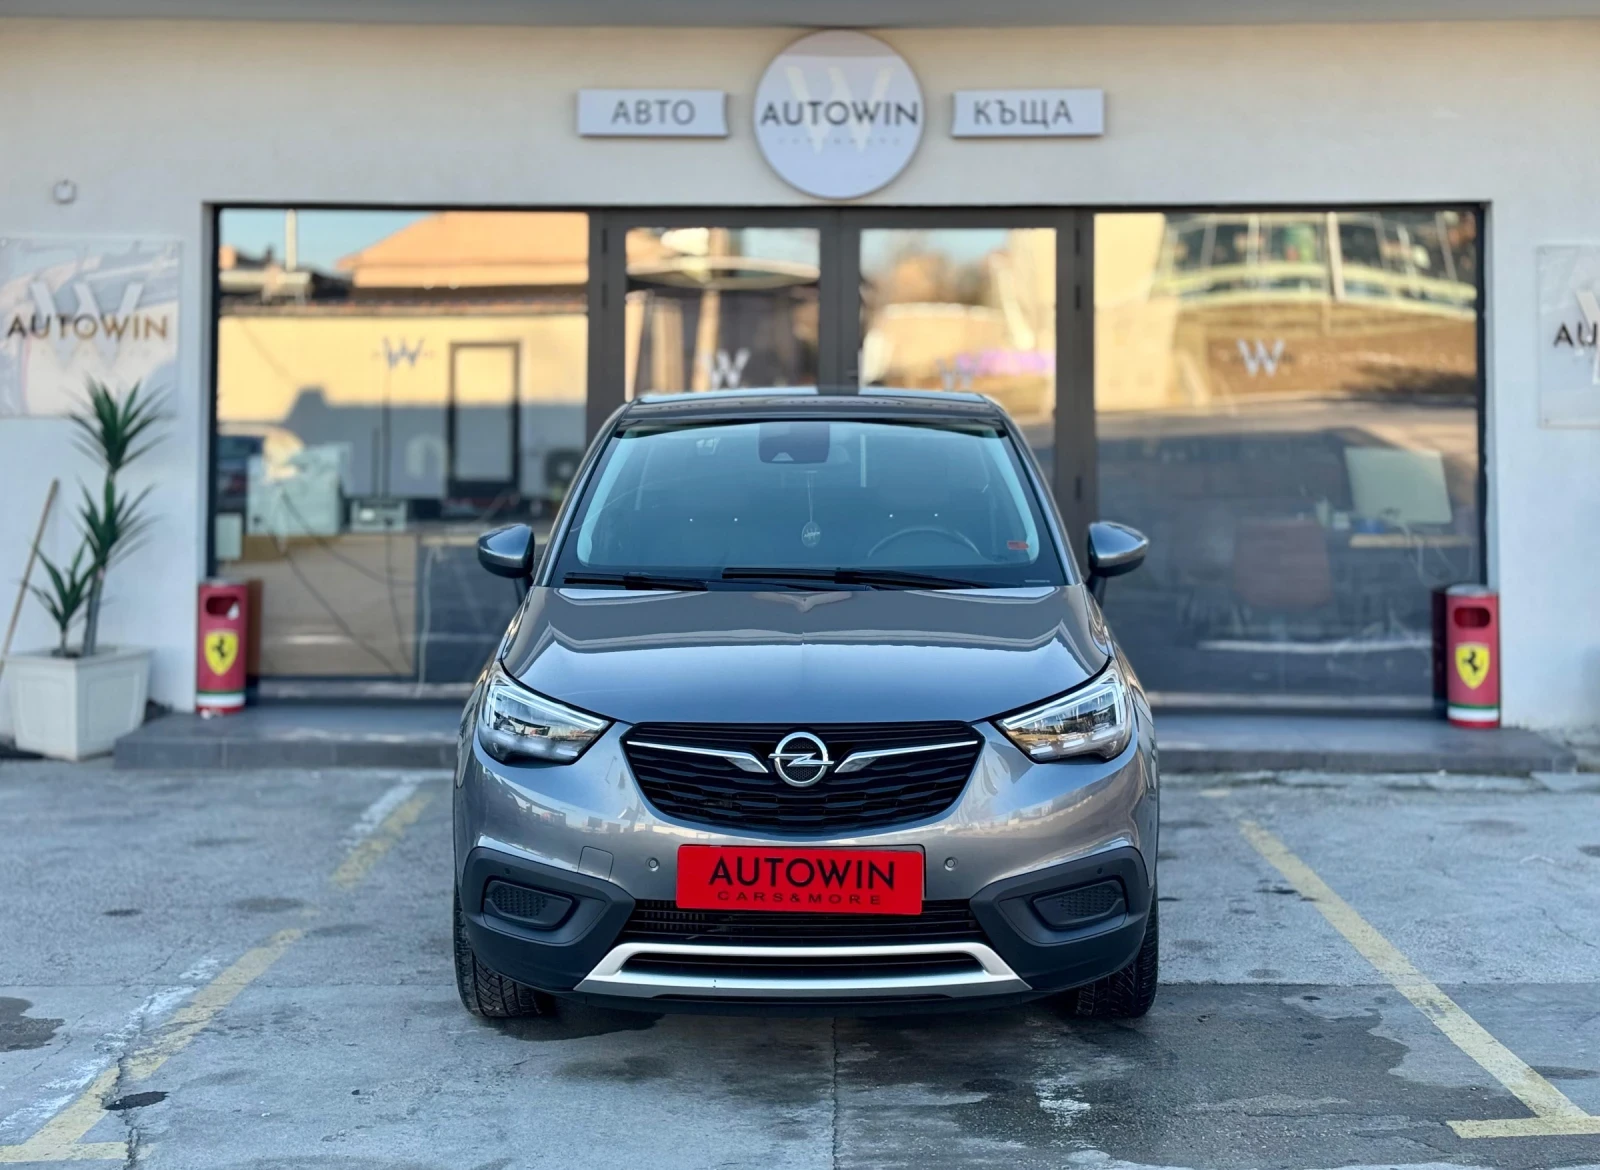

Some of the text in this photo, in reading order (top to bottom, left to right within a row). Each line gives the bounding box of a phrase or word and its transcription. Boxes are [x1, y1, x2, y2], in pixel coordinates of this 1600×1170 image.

[610, 98, 696, 126] АВТО
[760, 100, 918, 127] AUTOWIN
[973, 98, 1074, 130] КЪЩА
[7, 312, 169, 342] AUTOWIN
[1236, 337, 1285, 377] W
[708, 855, 895, 890] AUTOWIN
[717, 890, 881, 906] CARS&MORE
